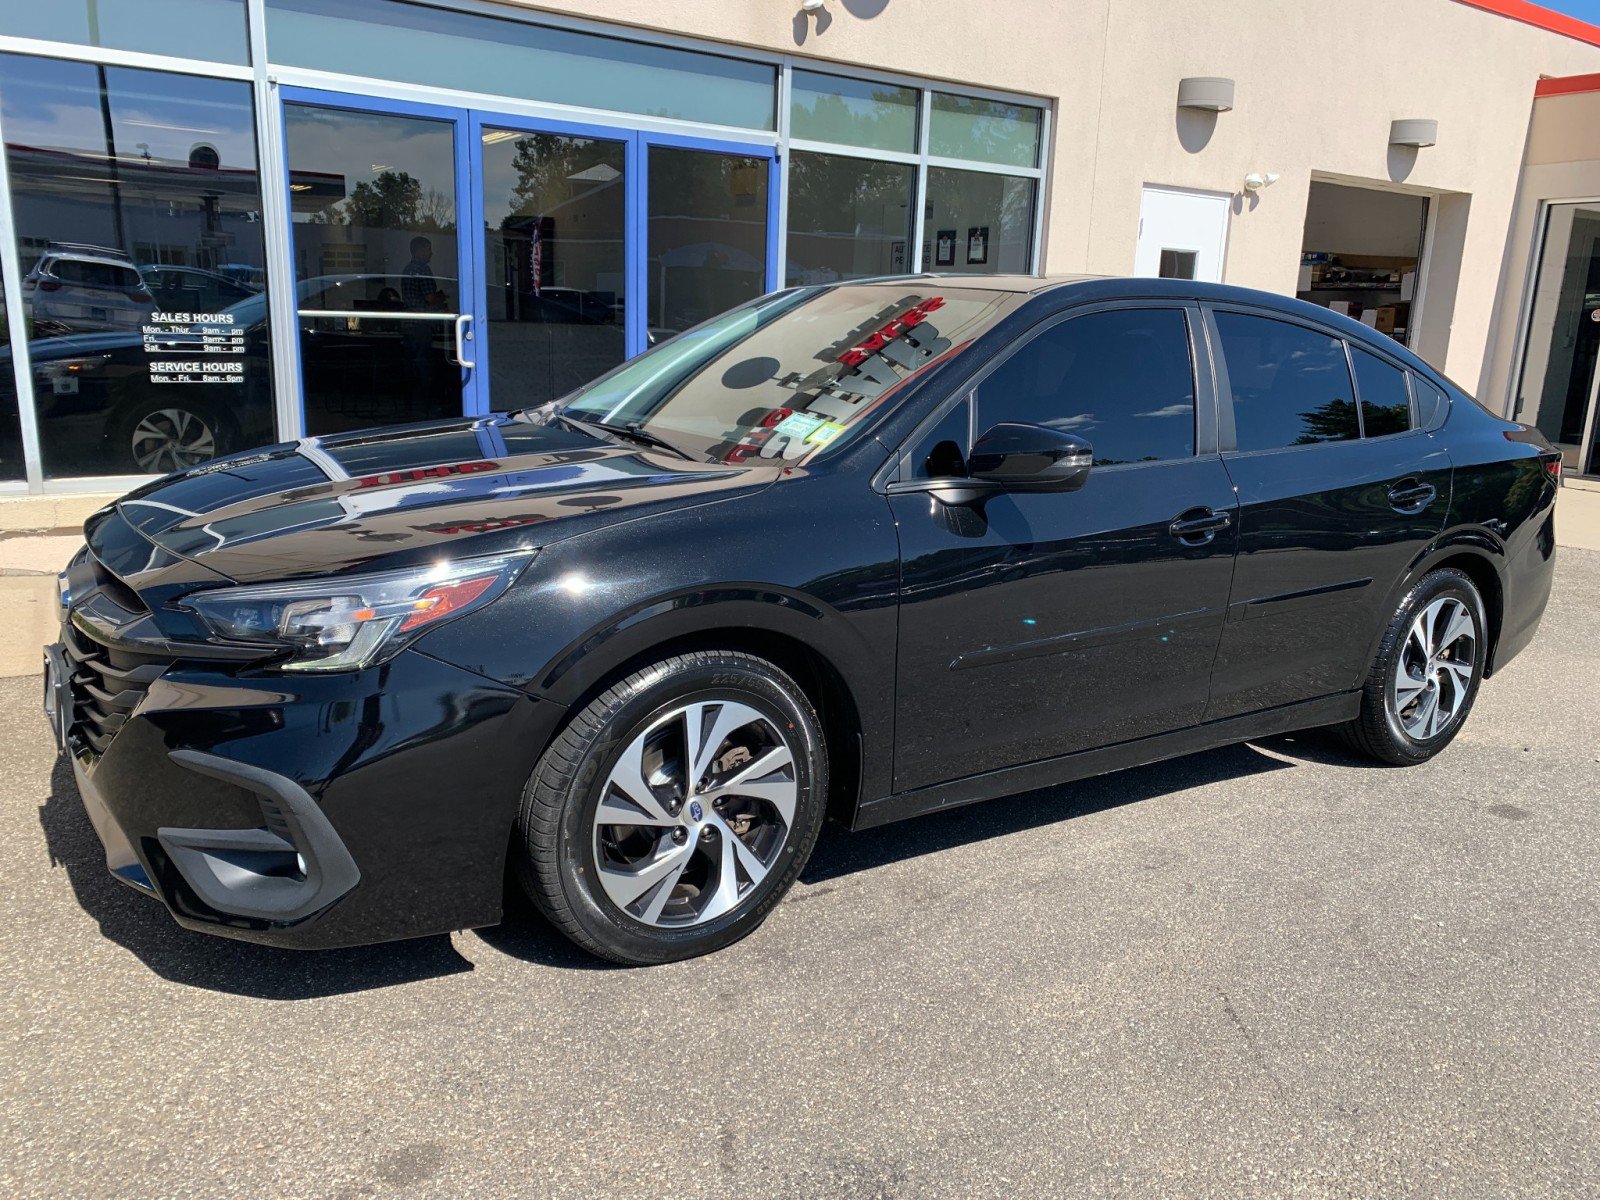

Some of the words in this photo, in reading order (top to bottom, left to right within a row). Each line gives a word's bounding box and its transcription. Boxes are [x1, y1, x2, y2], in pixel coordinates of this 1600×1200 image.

[151, 312, 190, 323] SALES
[193, 313, 234, 324] HOURS
[142, 325, 163, 334] Mon.
[170, 325, 191, 334] Thur.
[202, 326, 219, 334] 9am
[143, 334, 157, 342] Fri.
[144, 343, 161, 351] Sat.
[149, 362, 200, 372] SERVICE
[202, 362, 243, 372] HOURS
